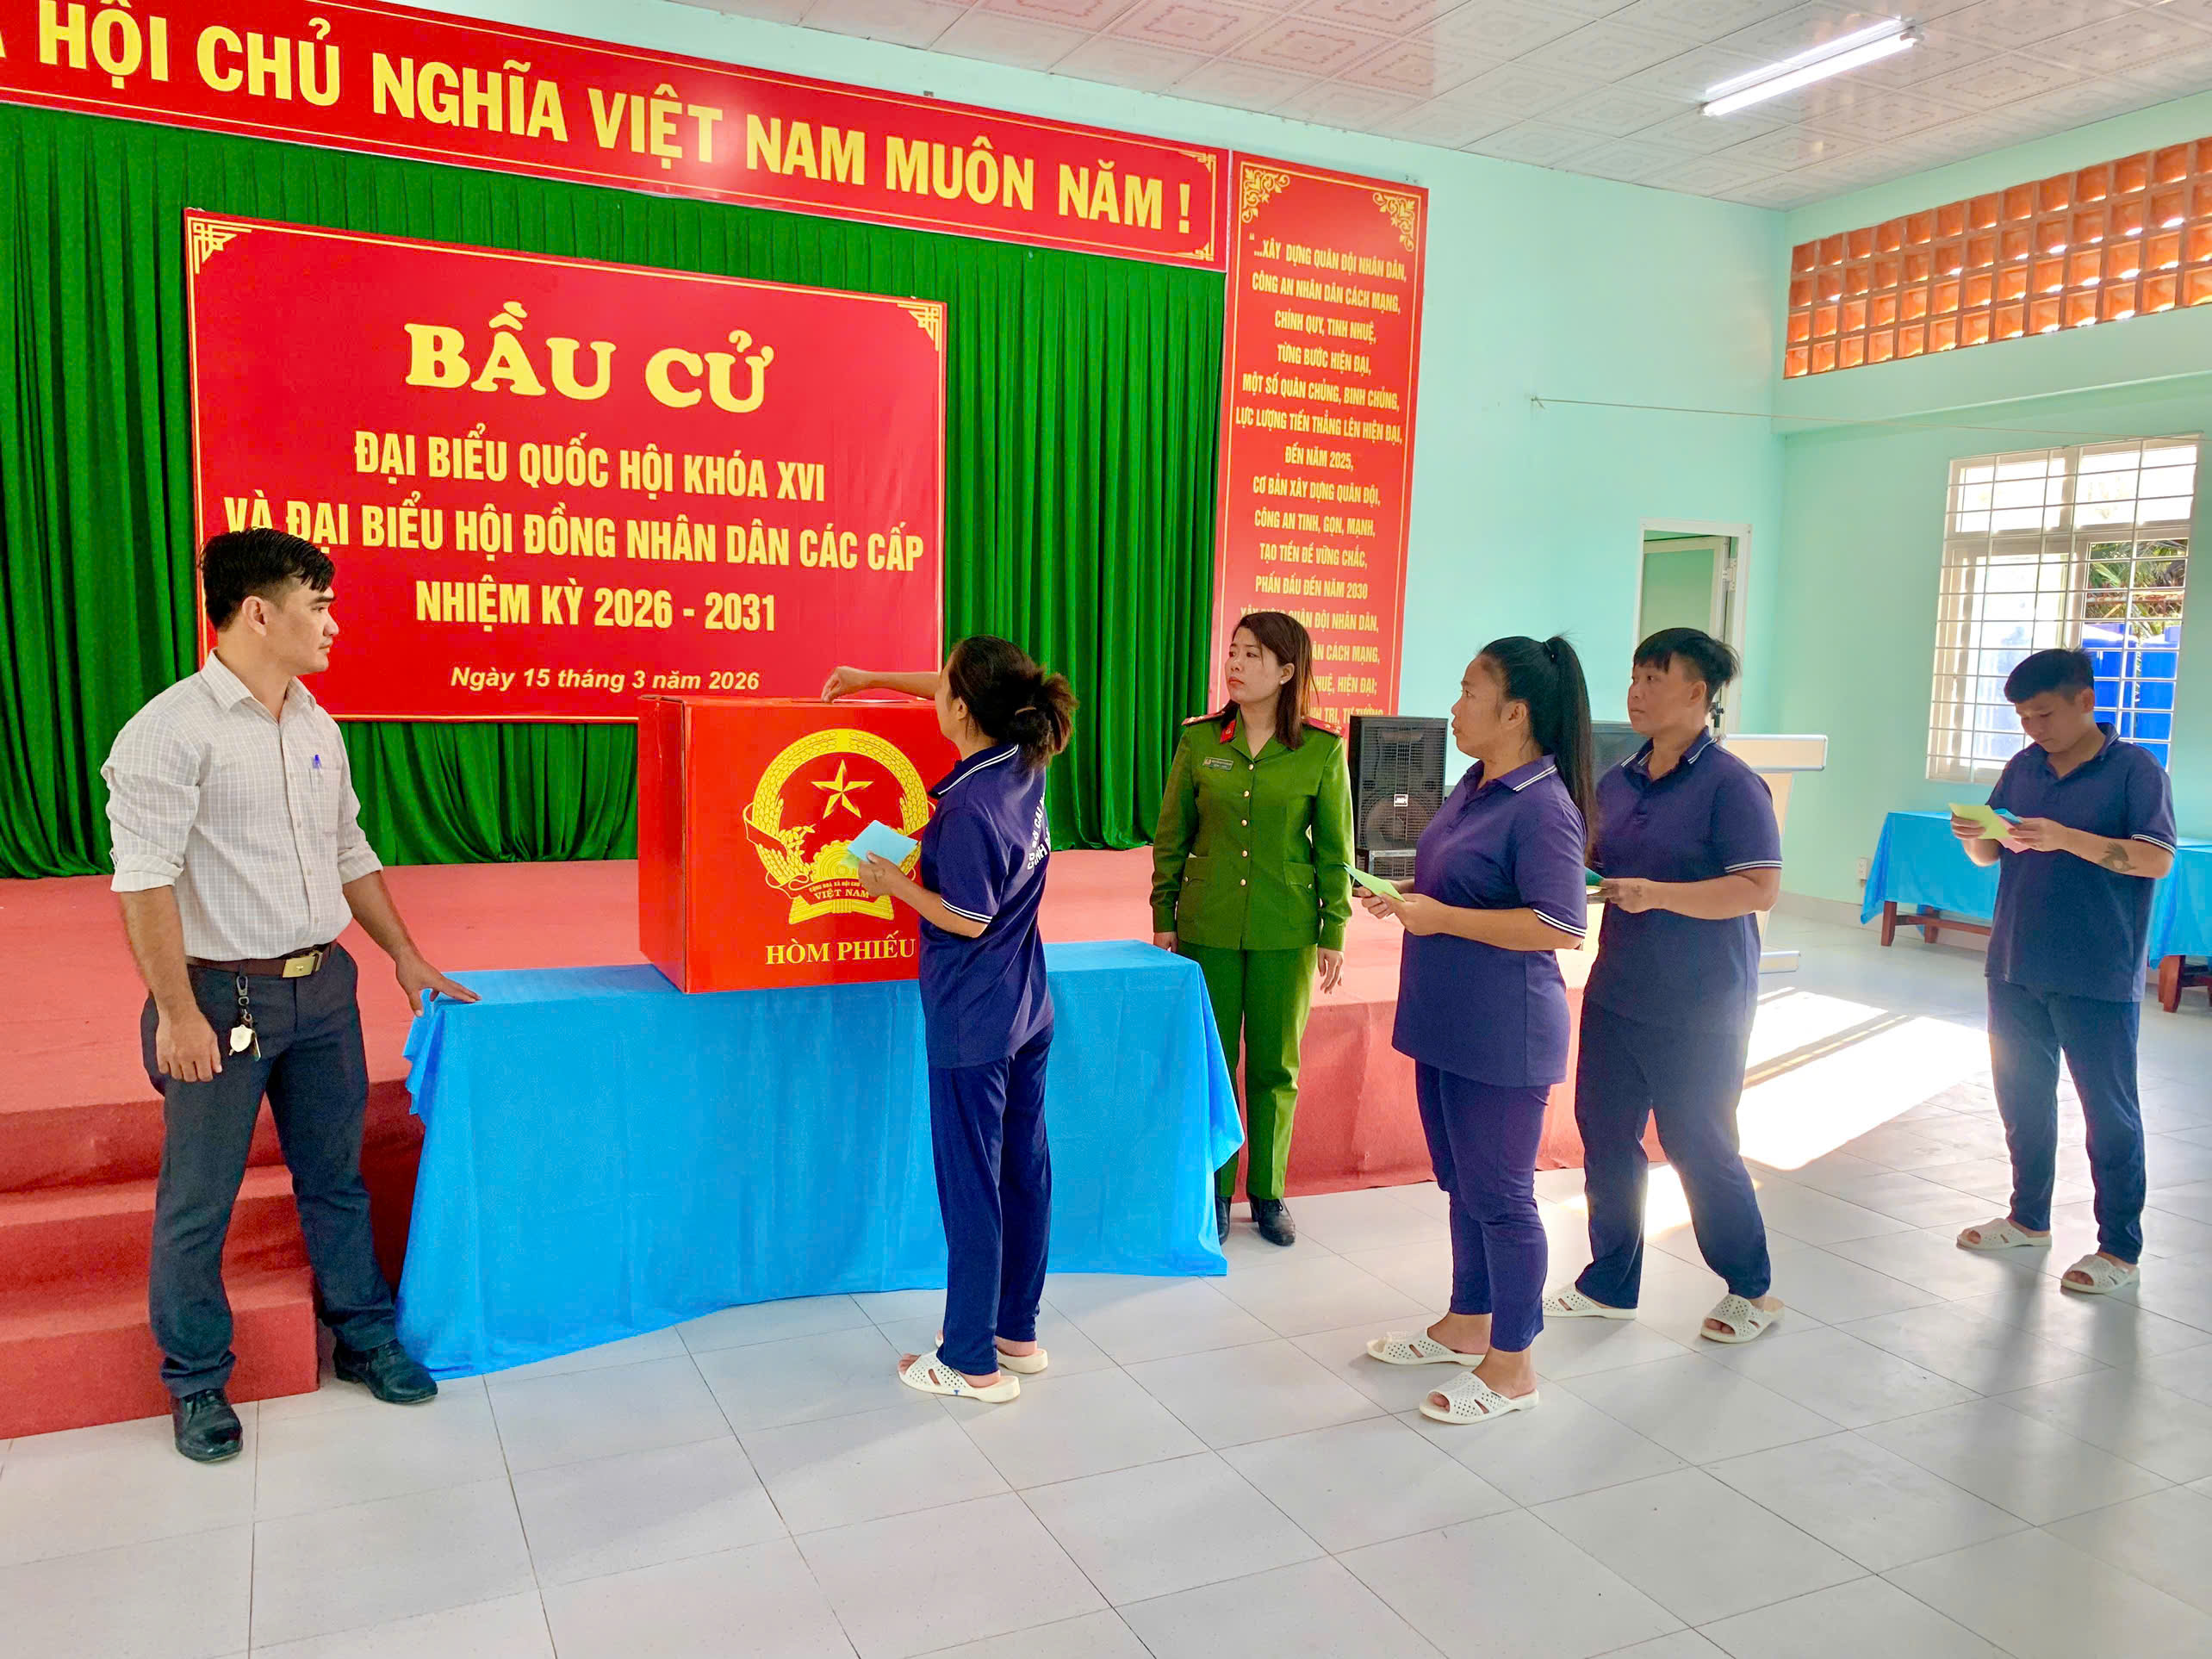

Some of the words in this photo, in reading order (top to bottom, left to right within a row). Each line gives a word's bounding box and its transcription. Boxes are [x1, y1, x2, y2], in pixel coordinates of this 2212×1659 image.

[39, 0, 169, 90] HỘI
[196, 17, 340, 106] CHỦ
[372, 52, 569, 142] NGHĨA
[587, 84, 724, 171] VIỆT
[746, 114, 866, 186] NAM
[885, 135, 1035, 211] MUÔN
[1059, 158, 1163, 230] NĂM
[1178, 183, 1190, 234] !
[1286, 244, 1312, 267] DỰNG
[1314, 248, 1339, 270] QUÂN
[1341, 252, 1357, 276] ĐỘI
[1359, 256, 1383, 278] NHÂN
[1252, 270, 1278, 294] CÔNG
[1280, 277, 1294, 296] AN
[1296, 279, 1322, 301] NHÂN
[1324, 282, 1344, 303] DÂN
[1345, 286, 1370, 308] CÁCH
[1371, 292, 1401, 315] MẠNG,
[1275, 308, 1304, 331] CHÍNH
[1306, 315, 1325, 337] QUY,
[1327, 318, 1348, 339] TINH
[1350, 320, 1376, 345] NHUỆ,
[404, 301, 617, 401] BẦU
[644, 329, 774, 413] CỬ
[1277, 341, 1302, 365] TỪNG
[1303, 345, 1329, 369] BƯỚC
[1330, 350, 1351, 375] HIỆN
[1354, 355, 1371, 376] ĐẠI,
[1242, 371, 1264, 396] MỘT
[1265, 371, 1279, 395] SỐ
[1281, 376, 1306, 399] QUÂN
[1344, 387, 1366, 407] BINH
[1235, 406, 1254, 429] LỰC
[1256, 407, 1288, 432] LƯỢNG
[1289, 408, 1309, 432] TIẾN
[1344, 416, 1360, 438] LÊN
[1362, 419, 1383, 444] HIỆN
[1385, 425, 1403, 446] ĐẠI,
[354, 431, 416, 485] ĐẠI
[428, 422, 507, 482] BIỂU
[519, 432, 609, 488] QUỐC
[619, 443, 674, 492] HỘI
[684, 450, 768, 499] KHÓA
[776, 461, 824, 502] XVI
[1284, 441, 1305, 465] ĐẾN
[1306, 445, 1327, 468] NĂM
[1329, 450, 1353, 472] 2025,
[1252, 475, 1266, 494] CƠ
[1268, 472, 1288, 496] BẢN
[1289, 476, 1308, 498] XÂY
[1309, 481, 1334, 503] DỰNG
[1337, 482, 1361, 504] QUÂN
[1363, 484, 1381, 508] ĐỘI,
[223, 488, 273, 534] VÀ
[285, 500, 349, 554] ĐẠI
[362, 490, 444, 550] BIỂU
[455, 502, 513, 562] HỘI
[523, 501, 616, 558] ĐỒNG
[626, 513, 717, 562] NHÂN
[726, 518, 790, 566] DÂN
[799, 523, 858, 569] CÁC
[867, 521, 924, 572] CẤP
[1254, 506, 1281, 529] CÔNG
[1282, 512, 1296, 530] AN
[1298, 513, 1320, 534] TINH,
[1323, 515, 1344, 537] GỌN,
[1347, 518, 1376, 538] MẠNH,
[1259, 543, 1277, 564] TẠO
[1315, 544, 1339, 566] VỮNG
[1255, 570, 1281, 593] PHẤN
[1283, 572, 1302, 596] ĐẤU
[1303, 575, 1322, 597] ĐẾN
[1323, 577, 1345, 599] NĂM
[1346, 582, 1368, 600] 2030
[416, 574, 530, 632] NHIỆM
[541, 577, 584, 625] KỲ
[594, 587, 673, 629] 2026
[683, 608, 695, 617] -
[705, 592, 774, 631] 2031
[1314, 610, 1330, 632] ĐỘI
[1332, 610, 1357, 631] NHÂN
[1311, 640, 1325, 661] ÂN
[1326, 641, 1350, 662] CÁCH
[450, 667, 516, 692] Ngày
[524, 668, 550, 687] 15
[557, 668, 625, 693] tháng
[631, 670, 646, 689] 3
[652, 670, 701, 689] năm
[708, 671, 760, 690] 2026
[1337, 674, 1358, 696] HIỆN
[814, 888, 842, 900] VIỆT
[845, 888, 869, 898] NAM
[766, 938, 830, 965] HÒM
[837, 929, 916, 962] PHIẾU
